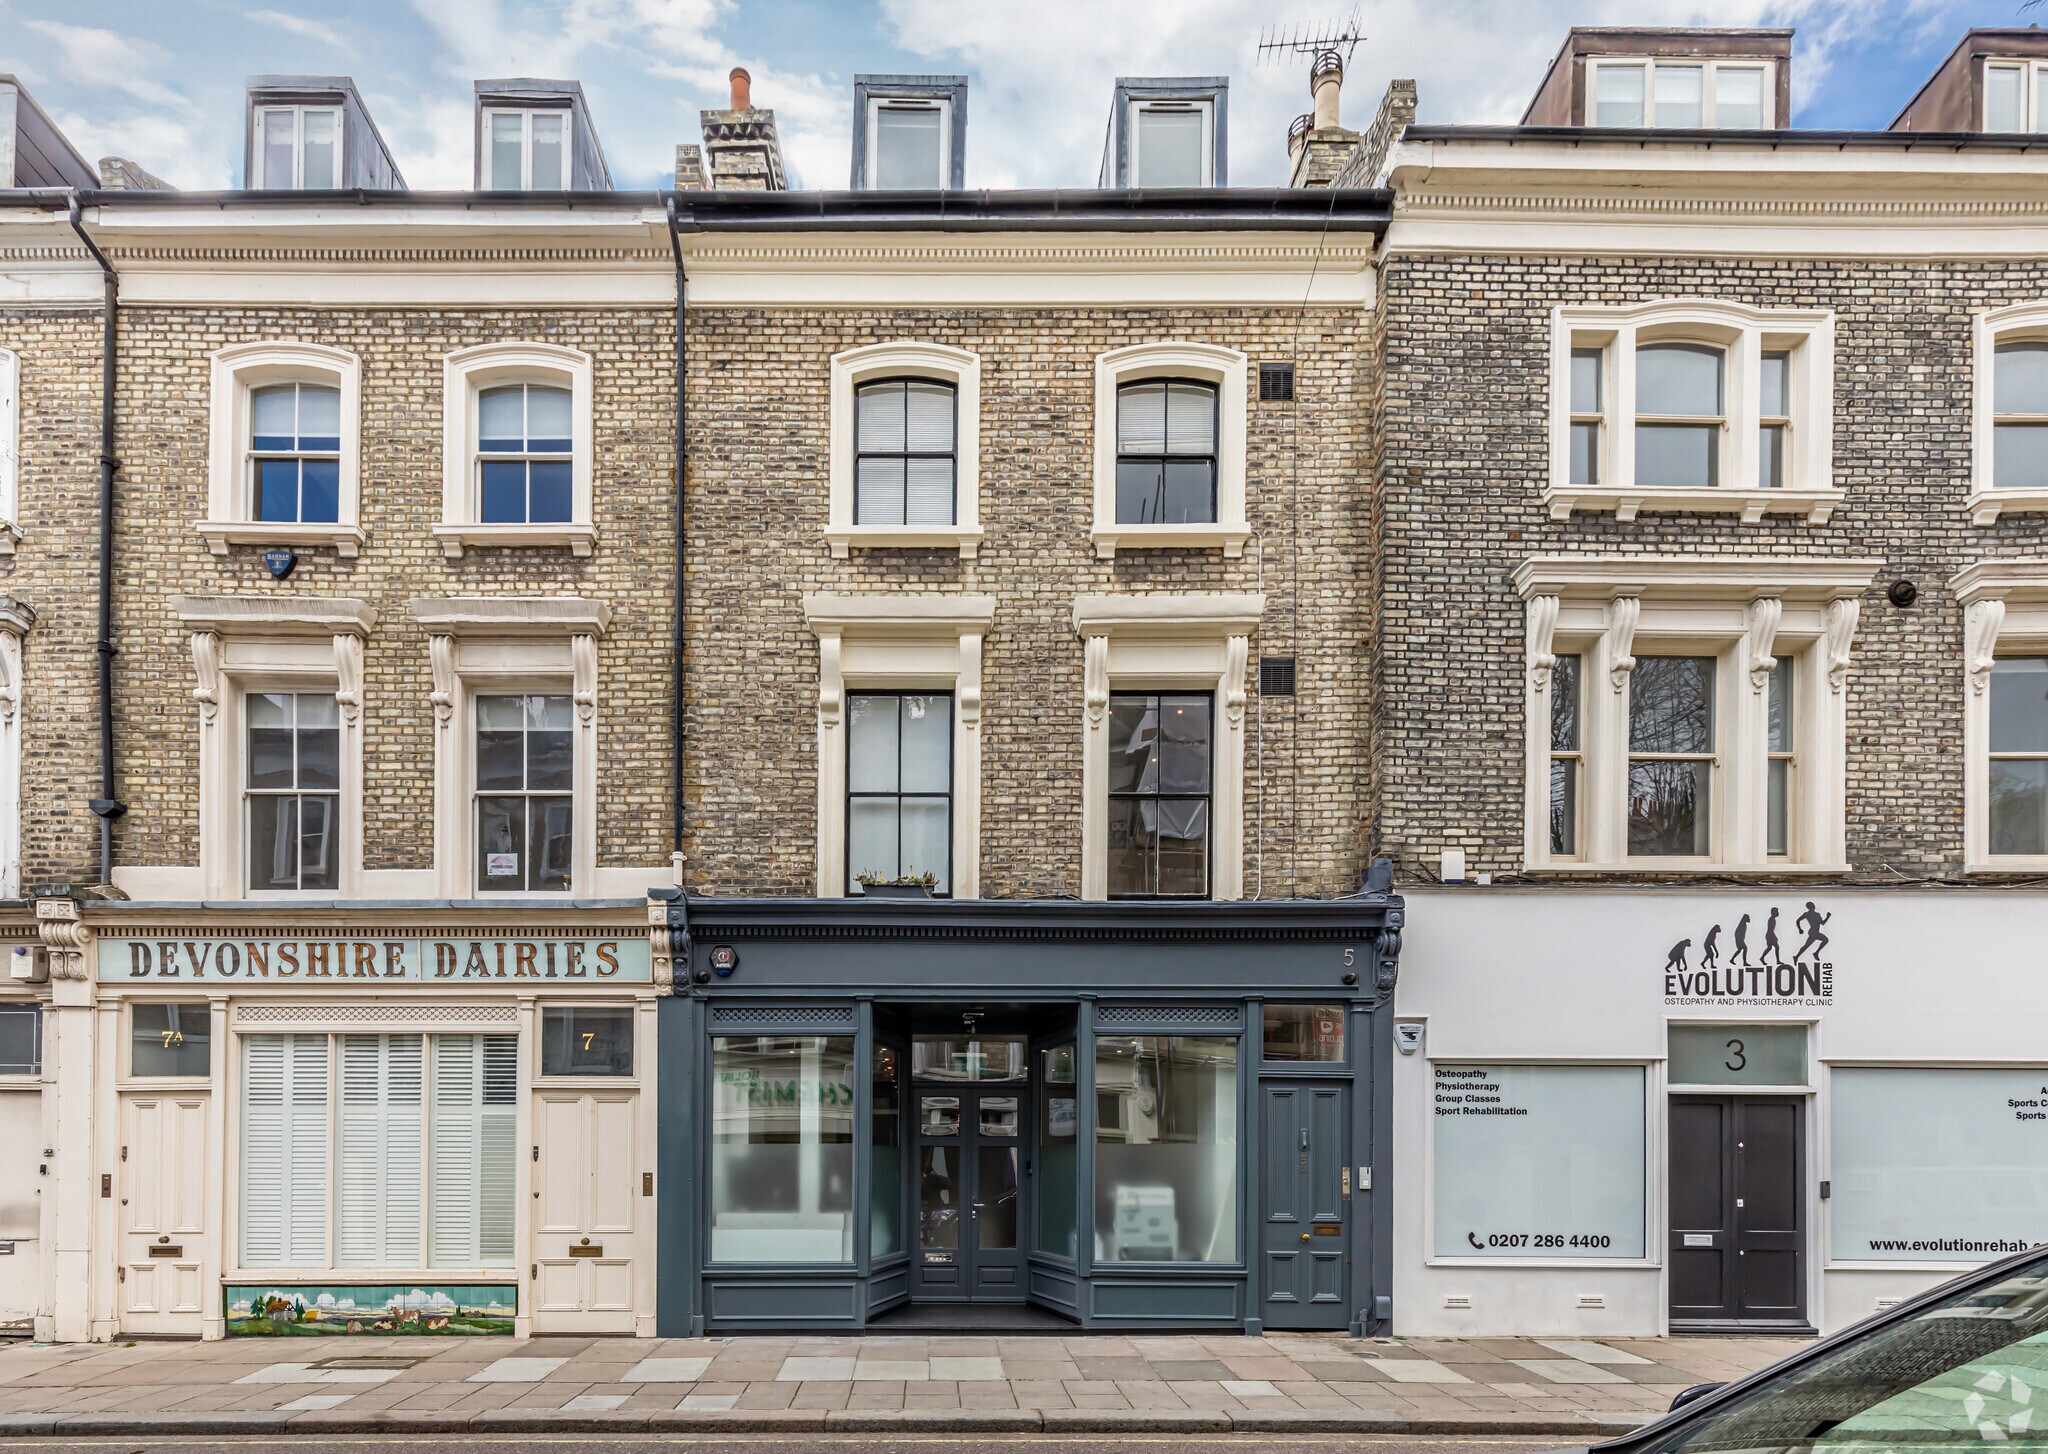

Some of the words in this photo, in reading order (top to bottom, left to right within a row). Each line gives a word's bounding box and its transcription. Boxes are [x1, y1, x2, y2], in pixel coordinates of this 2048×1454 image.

[128, 942, 406, 978] DEVONSHIRE
[433, 942, 620, 978] DAIRIES
[1343, 948, 1354, 967] 5
[1665, 962, 1821, 997] EVOLUTION
[1822, 962, 1833, 997] REHAB
[1664, 997, 1715, 1006] OSTEOPATHY
[1717, 997, 1735, 1006] AND
[1736, 998, 1804, 1006] PHYSIOTHERAPY
[1805, 998, 1833, 1007] CLINIC
[581, 1032, 596, 1051] 7
[1725, 1039, 1747, 1072] 3
[1435, 1069, 1488, 1080] Osteopathy
[1435, 1081, 1500, 1092] Physiotherapy
[1435, 1094, 1463, 1104] Group
[1465, 1094, 1501, 1103] Classes
[2007, 1098, 2039, 1109] Sports
[1435, 1106, 1460, 1117] Sport
[1462, 1106, 1528, 1116] Rehabilitation
[2015, 1111, 2047, 1121] Sports
[1488, 1234, 1529, 1247] 0207
[1533, 1234, 1565, 1248] 286
[1568, 1234, 1611, 1248] 4400
[1869, 1238, 2041, 1252] www.evolutionrehab
